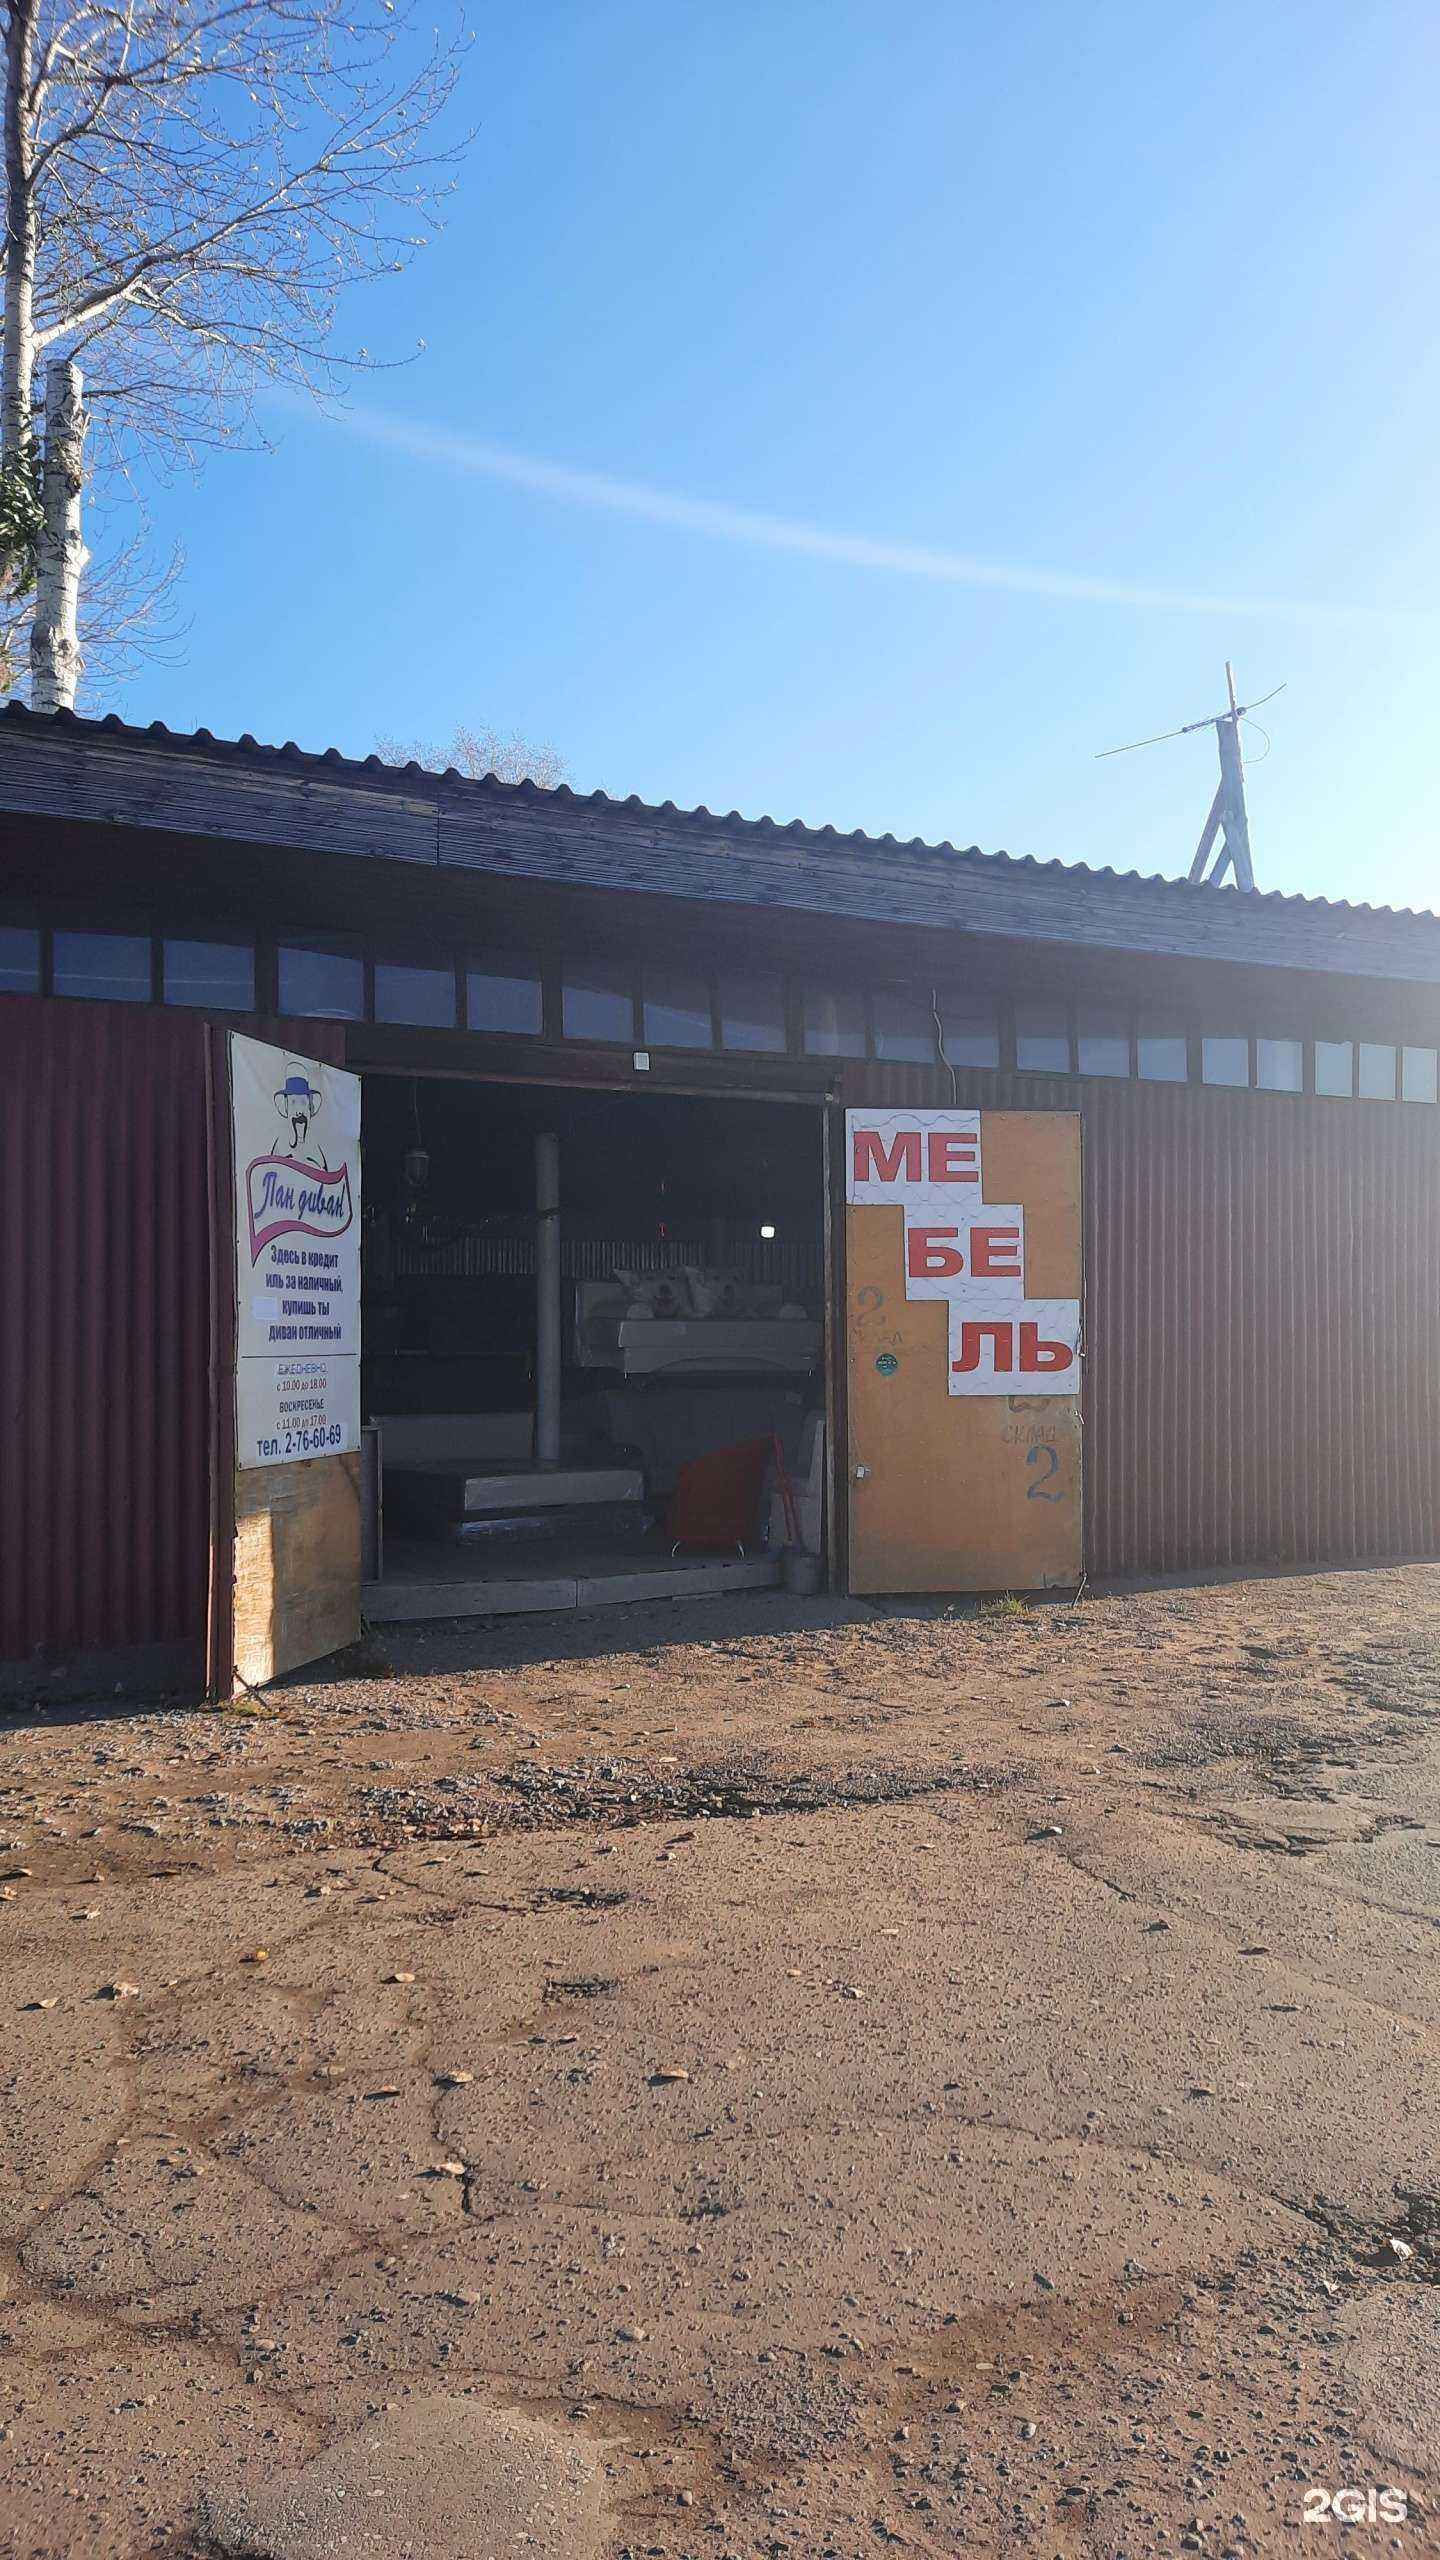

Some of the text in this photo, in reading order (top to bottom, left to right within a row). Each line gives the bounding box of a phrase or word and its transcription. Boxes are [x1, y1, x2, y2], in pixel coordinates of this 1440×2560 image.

[853, 1131, 979, 1182] МЕ
[254, 1171, 346, 1220] Пан диван
[270, 1245, 339, 1269] Здесь в кредит
[907, 1227, 1022, 1277] БЕ
[265, 1273, 344, 1293] иль за наличный,
[282, 1300, 330, 1316] купишь ты
[268, 1322, 342, 1342] диван отличный
[951, 1321, 1074, 1373] ЛЬ
[279, 1398, 325, 1413] ВОСКРЕСЕНЬЕ
[257, 1423, 341, 1457] тел. 2-76-60-69
[1026, 1443, 1066, 1504] 2
